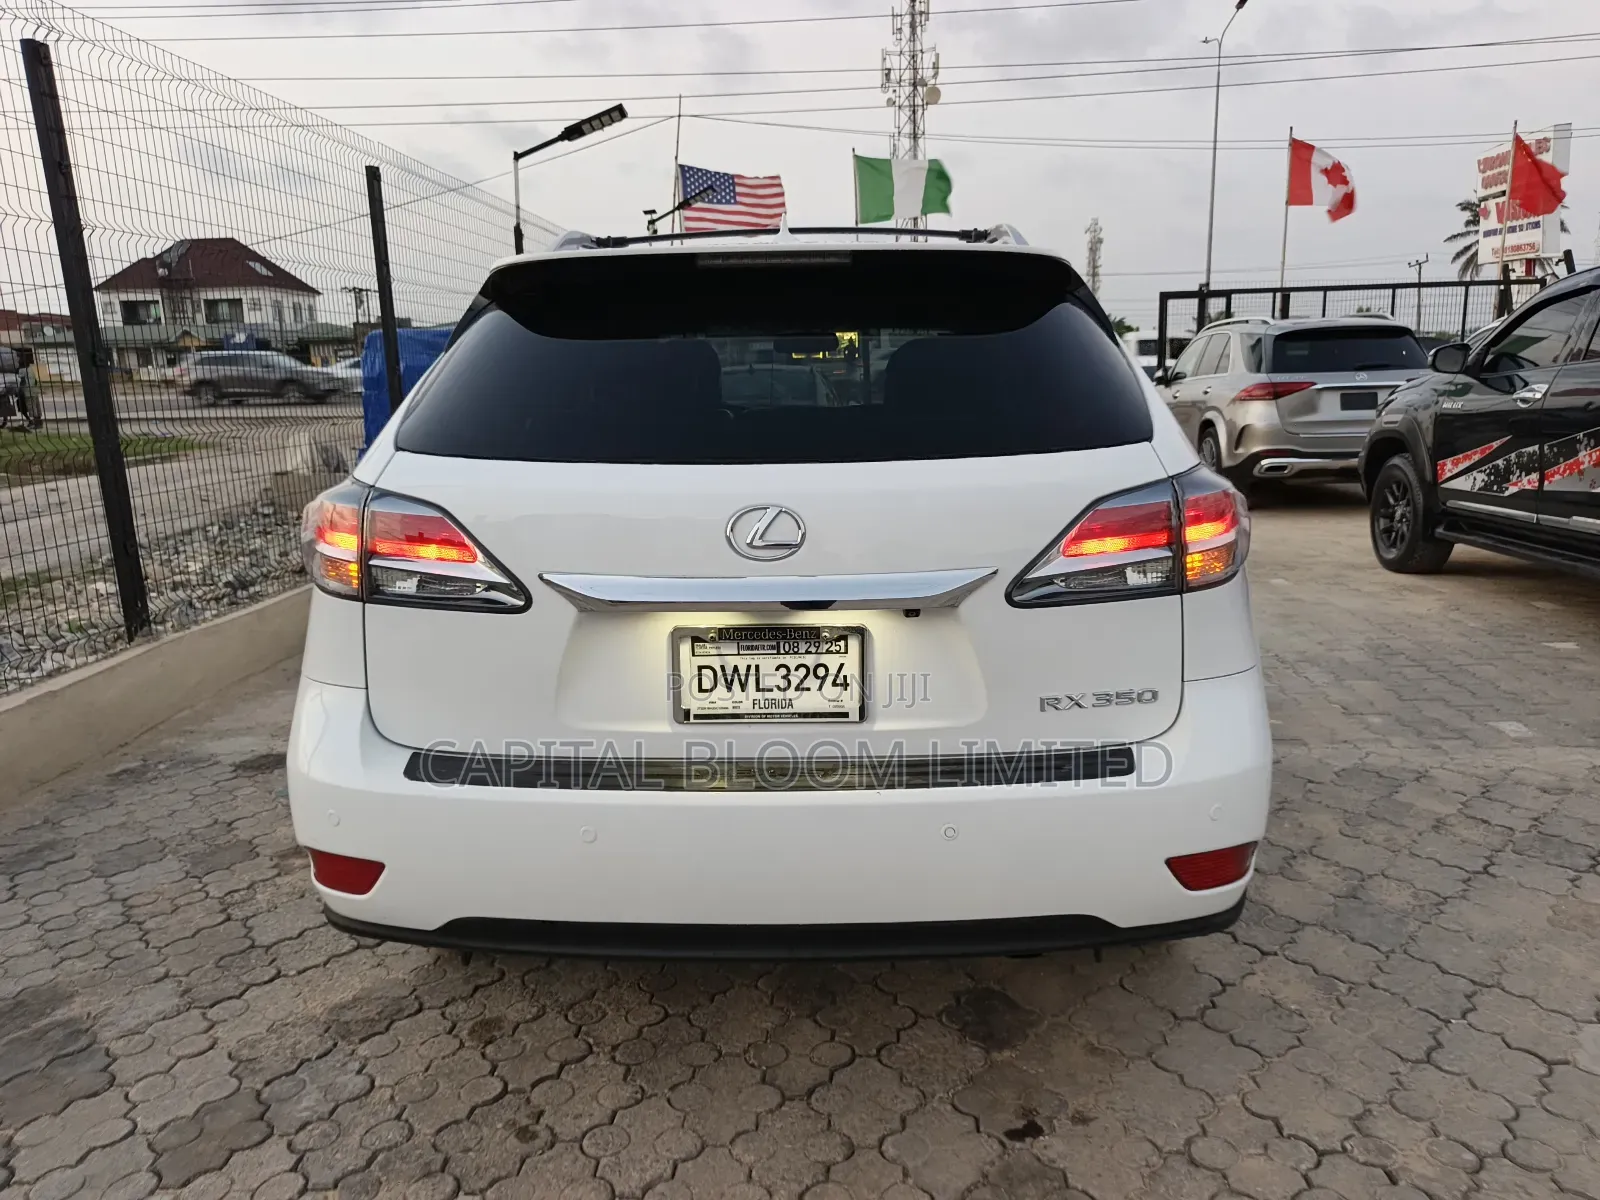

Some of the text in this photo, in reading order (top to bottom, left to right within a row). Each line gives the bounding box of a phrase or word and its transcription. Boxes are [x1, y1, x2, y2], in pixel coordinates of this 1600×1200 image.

[721, 628, 817, 640] Mercedes-Benz
[783, 642, 800, 653] 08
[804, 641, 820, 653] 29
[825, 640, 842, 653] 25
[697, 662, 850, 693] DWL3294
[752, 698, 794, 710] FLORIDA
[1039, 687, 1159, 712] RX 350
